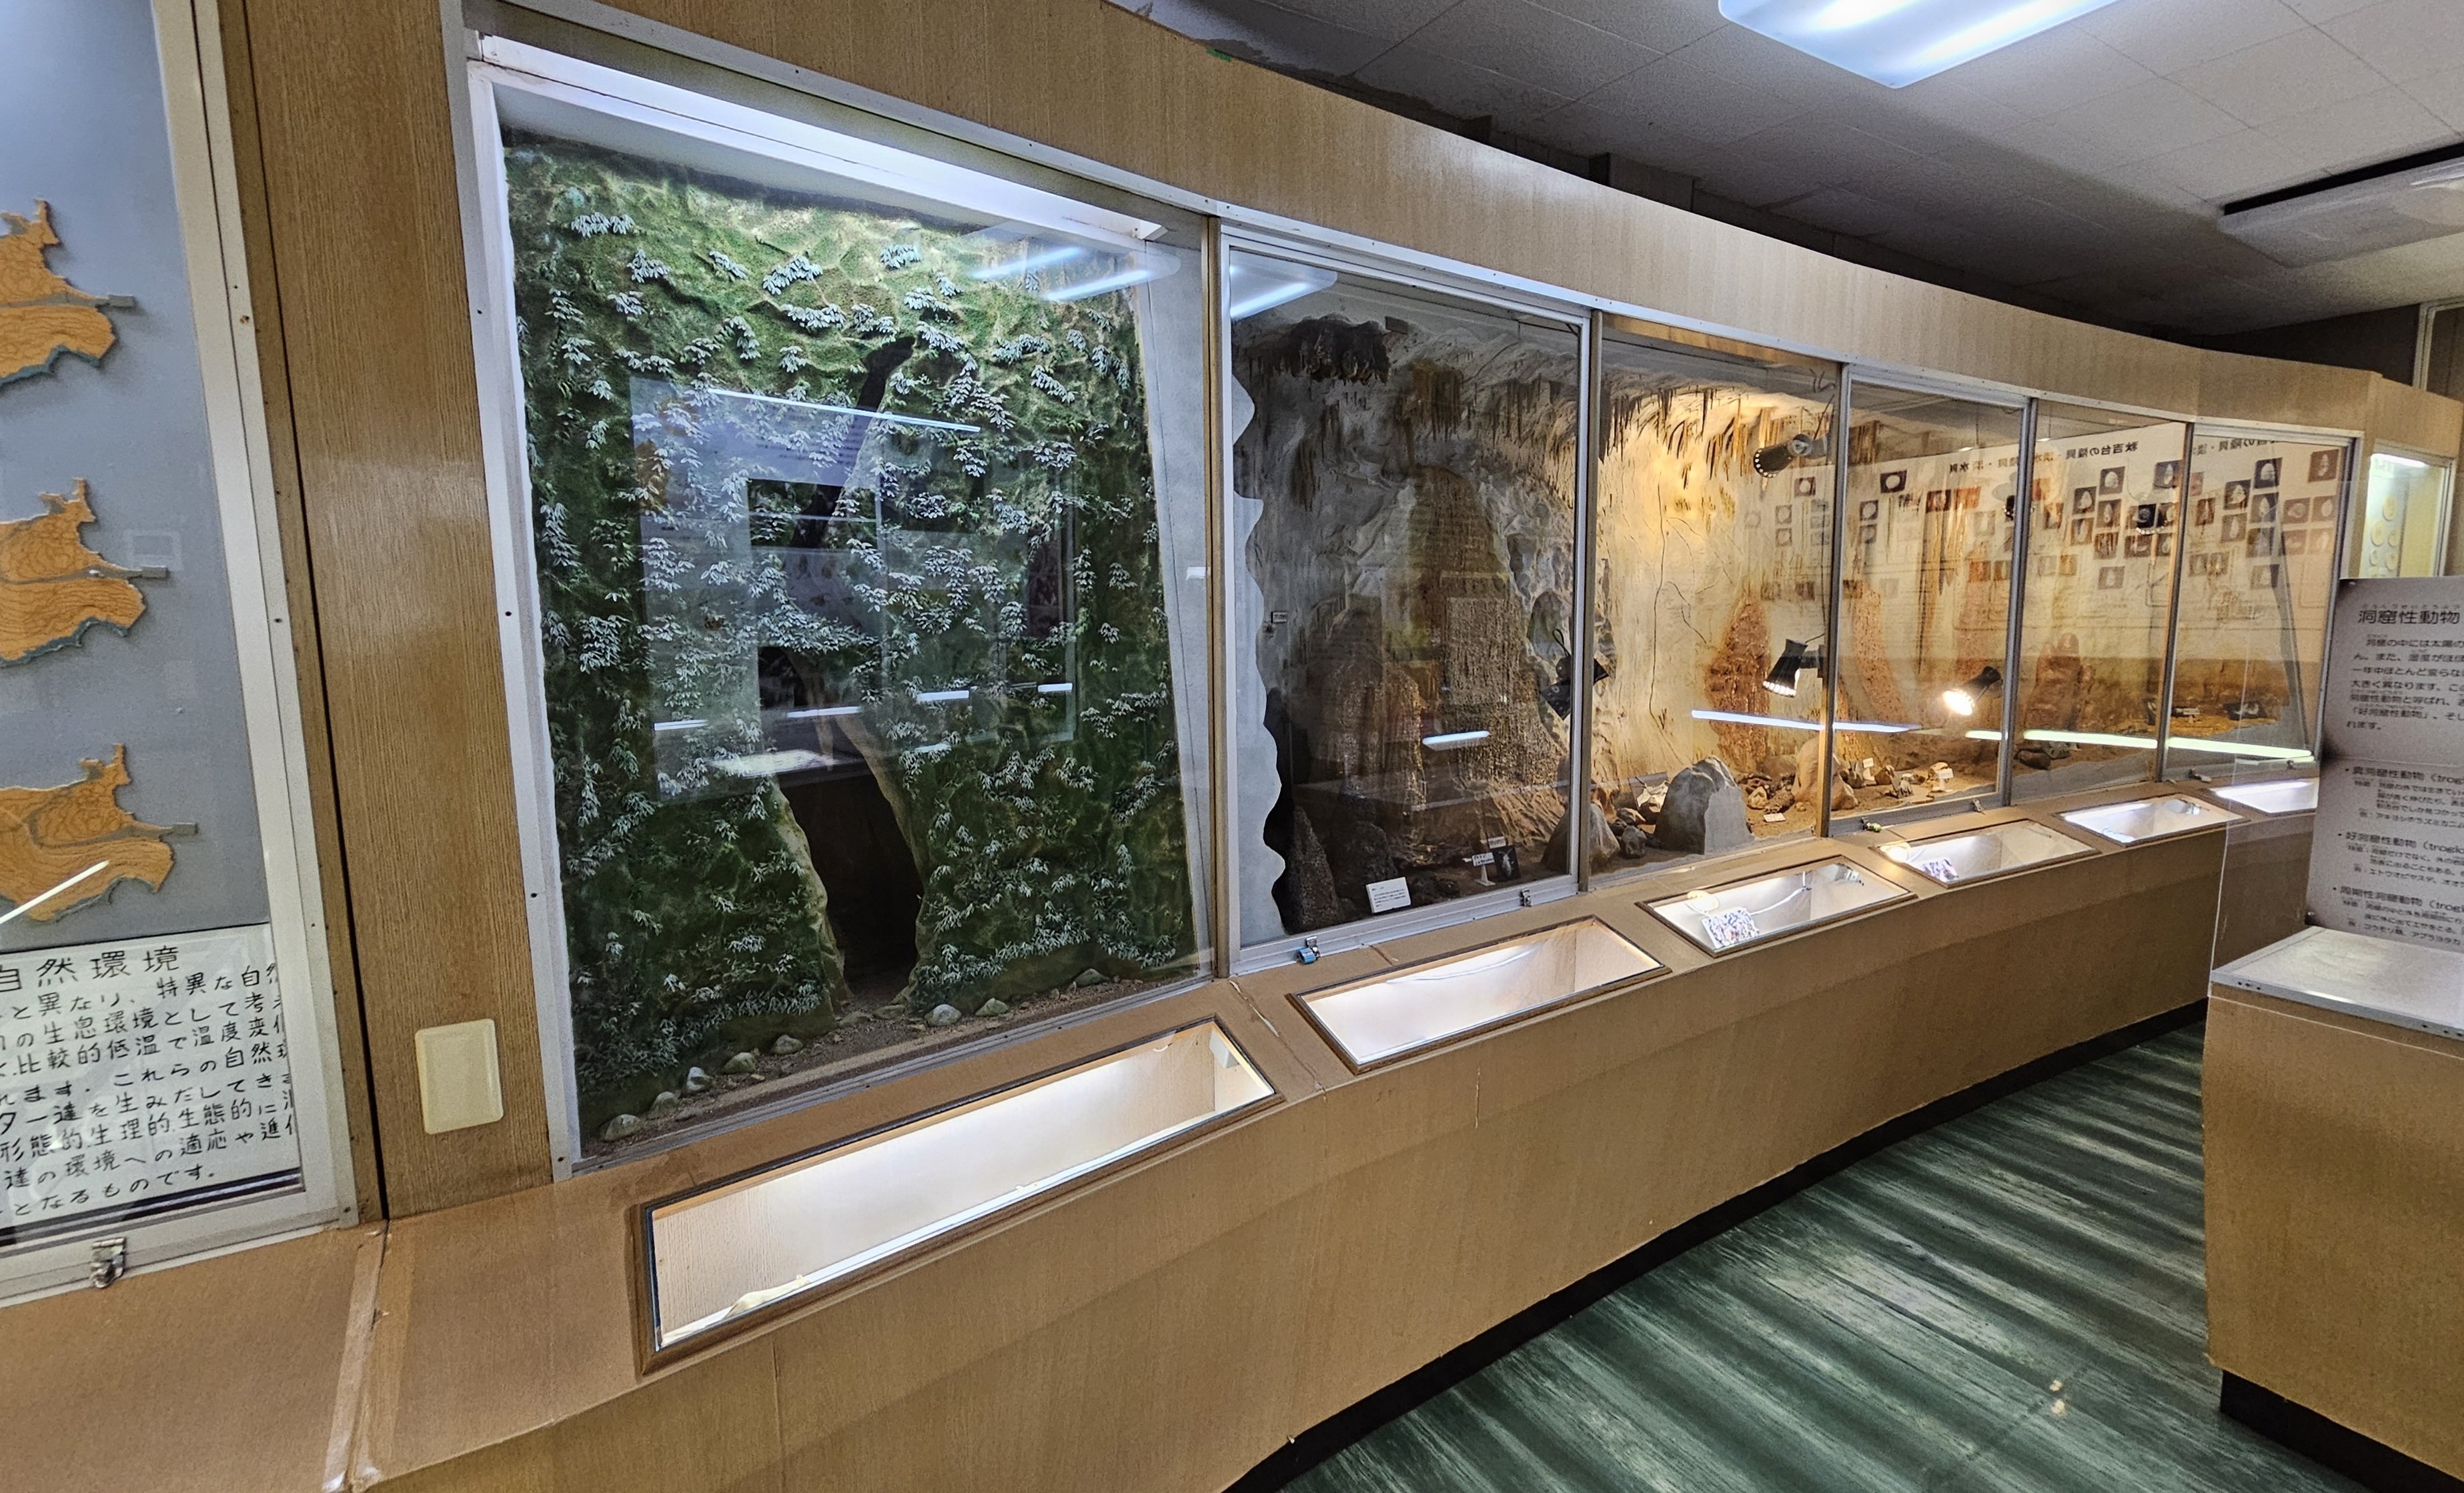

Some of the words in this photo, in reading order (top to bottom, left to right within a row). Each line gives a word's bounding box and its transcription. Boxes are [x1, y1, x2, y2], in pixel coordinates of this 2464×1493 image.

[2357, 609, 2461, 625] 洞窟性動物
[0, 945, 179, 992] 自然環境
[0, 992, 281, 1050] の生息環境として考
